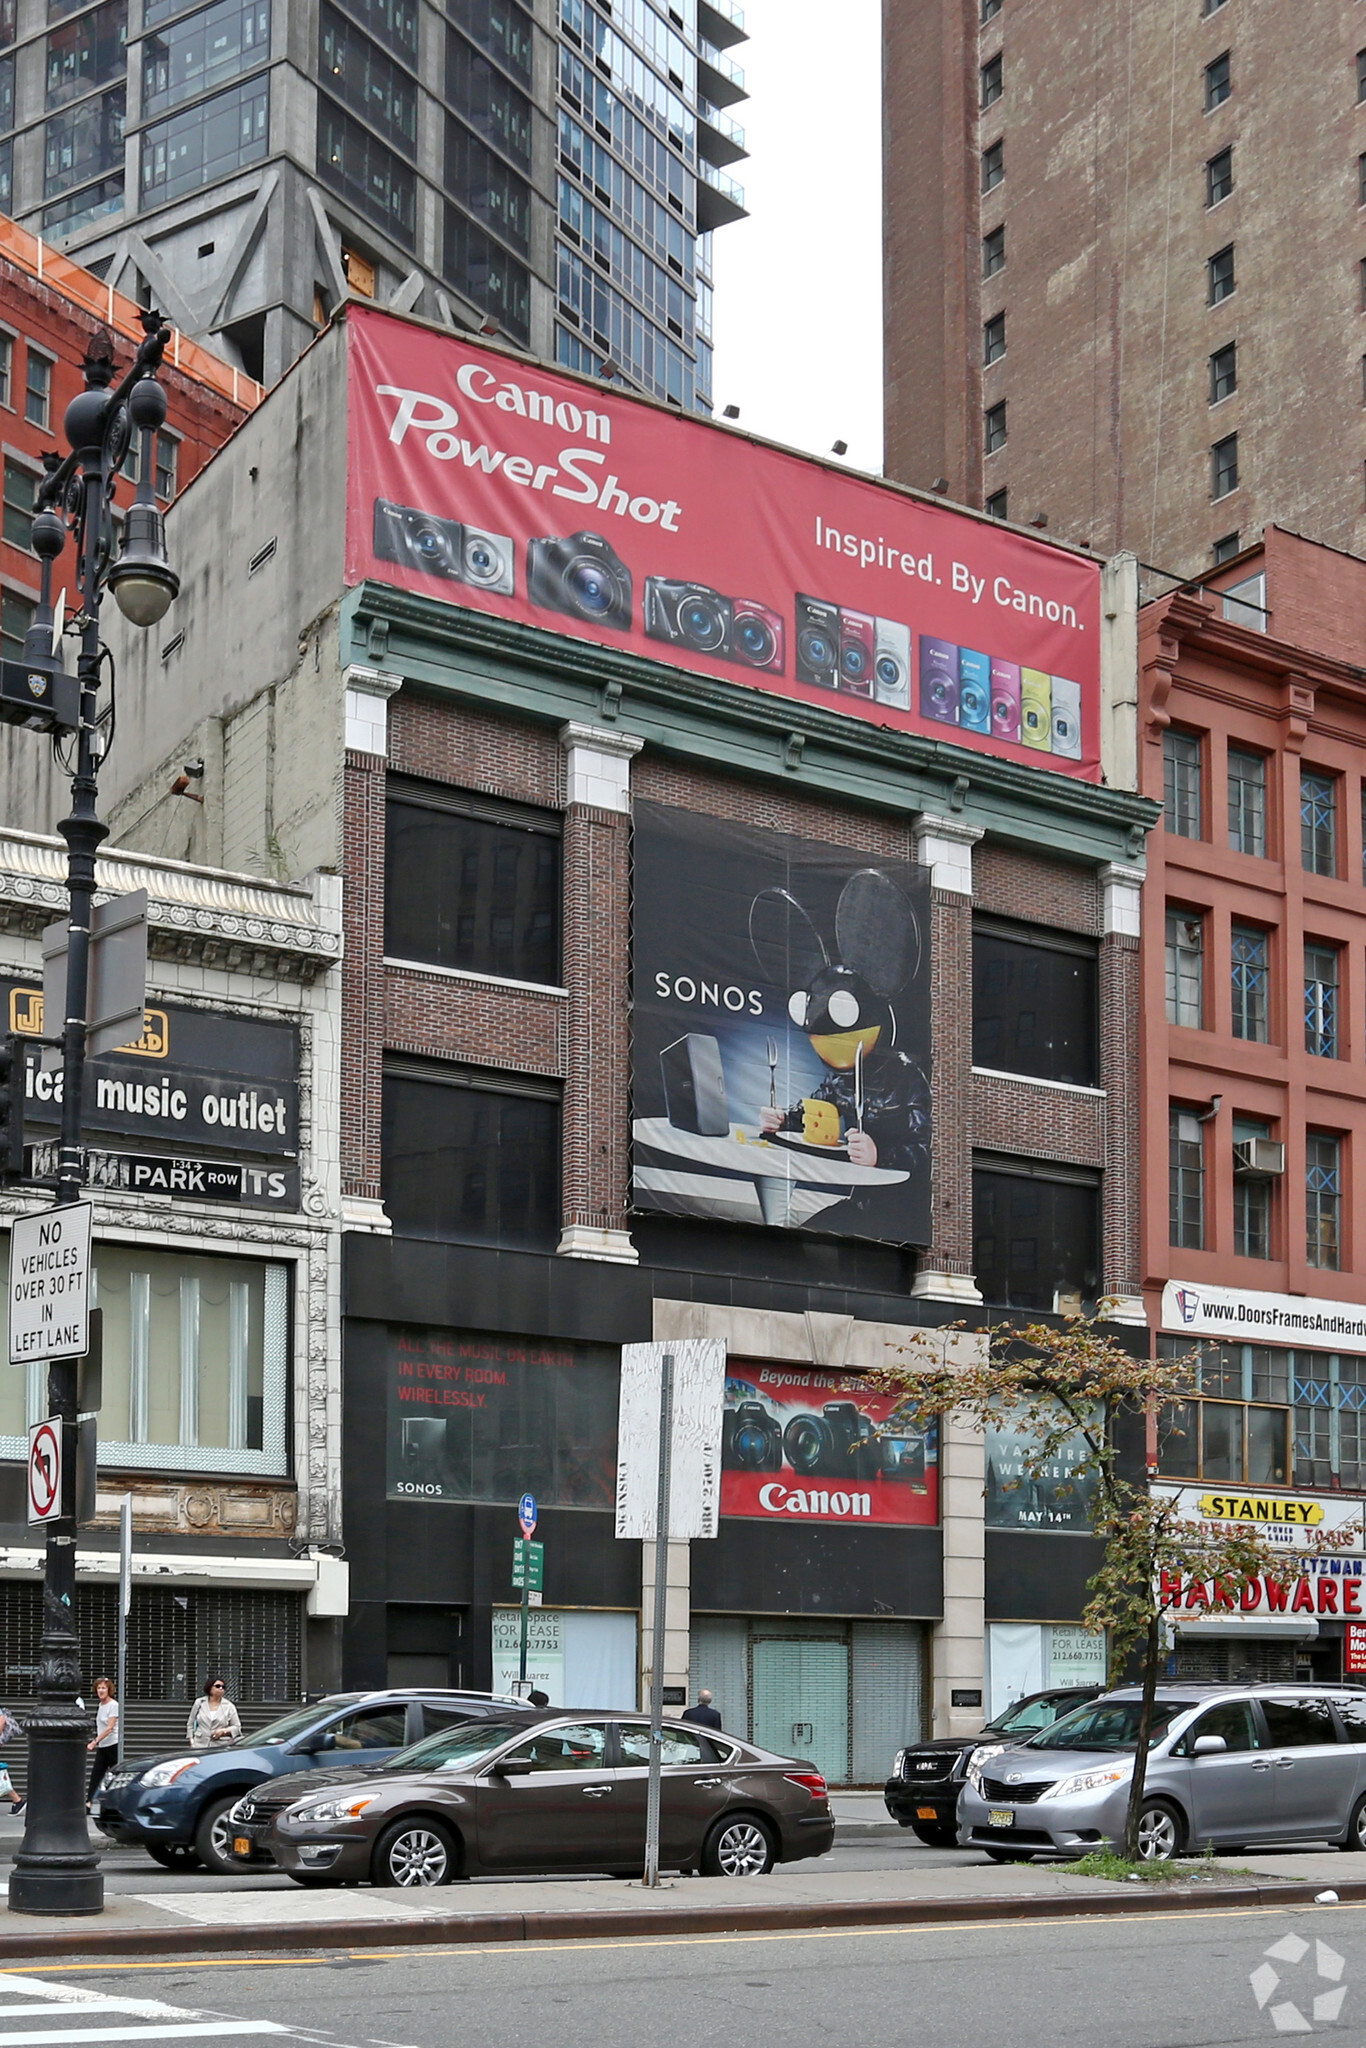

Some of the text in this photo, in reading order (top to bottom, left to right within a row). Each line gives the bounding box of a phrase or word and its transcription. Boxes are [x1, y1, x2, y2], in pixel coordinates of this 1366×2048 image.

[456, 364, 611, 444] Canon
[377, 384, 682, 532] PowerShot
[815, 516, 1085, 630] Inspired. By Canon.
[655, 971, 763, 1016] SONOS
[97, 1077, 188, 1121] music
[202, 1091, 287, 1135] outlet
[172, 1159, 191, 1170] 1-34
[134, 1165, 239, 1192] PARK ROW
[39, 1221, 62, 1247] NO
[21, 1247, 78, 1275] VEHICLES
[15, 1272, 83, 1302] OVER 30 FT
[42, 1303, 53, 1322] IN
[16, 1324, 80, 1352] LEFT LANE
[398, 1337, 425, 1353] ALL
[429, 1340, 456, 1356] THE
[460, 1343, 503, 1361] MUSIC
[506, 1348, 527, 1363] ON
[398, 1361, 510, 1386] IN EVERY ROOM.
[759, 1369, 810, 1389] Beyond
[813, 1375, 835, 1388] the
[397, 1386, 489, 1409] WIRELESSLY.
[1000, 1444, 1087, 1462] VAIRE
[397, 1481, 443, 1496] SONOS
[758, 1482, 871, 1517] Canon
[1018, 1510, 1072, 1523] MAY 14TH
[1211, 1497, 1314, 1523] STANLEY
[1267, 1526, 1294, 1534] POWER
[1159, 1570, 1363, 1615] HARDWARE
[492, 1611, 559, 1625] Retai Space
[494, 1625, 560, 1637] FOR EASE
[1052, 1627, 1103, 1639] Retail Spe
[1052, 1640, 1103, 1650] FOR LEASE
